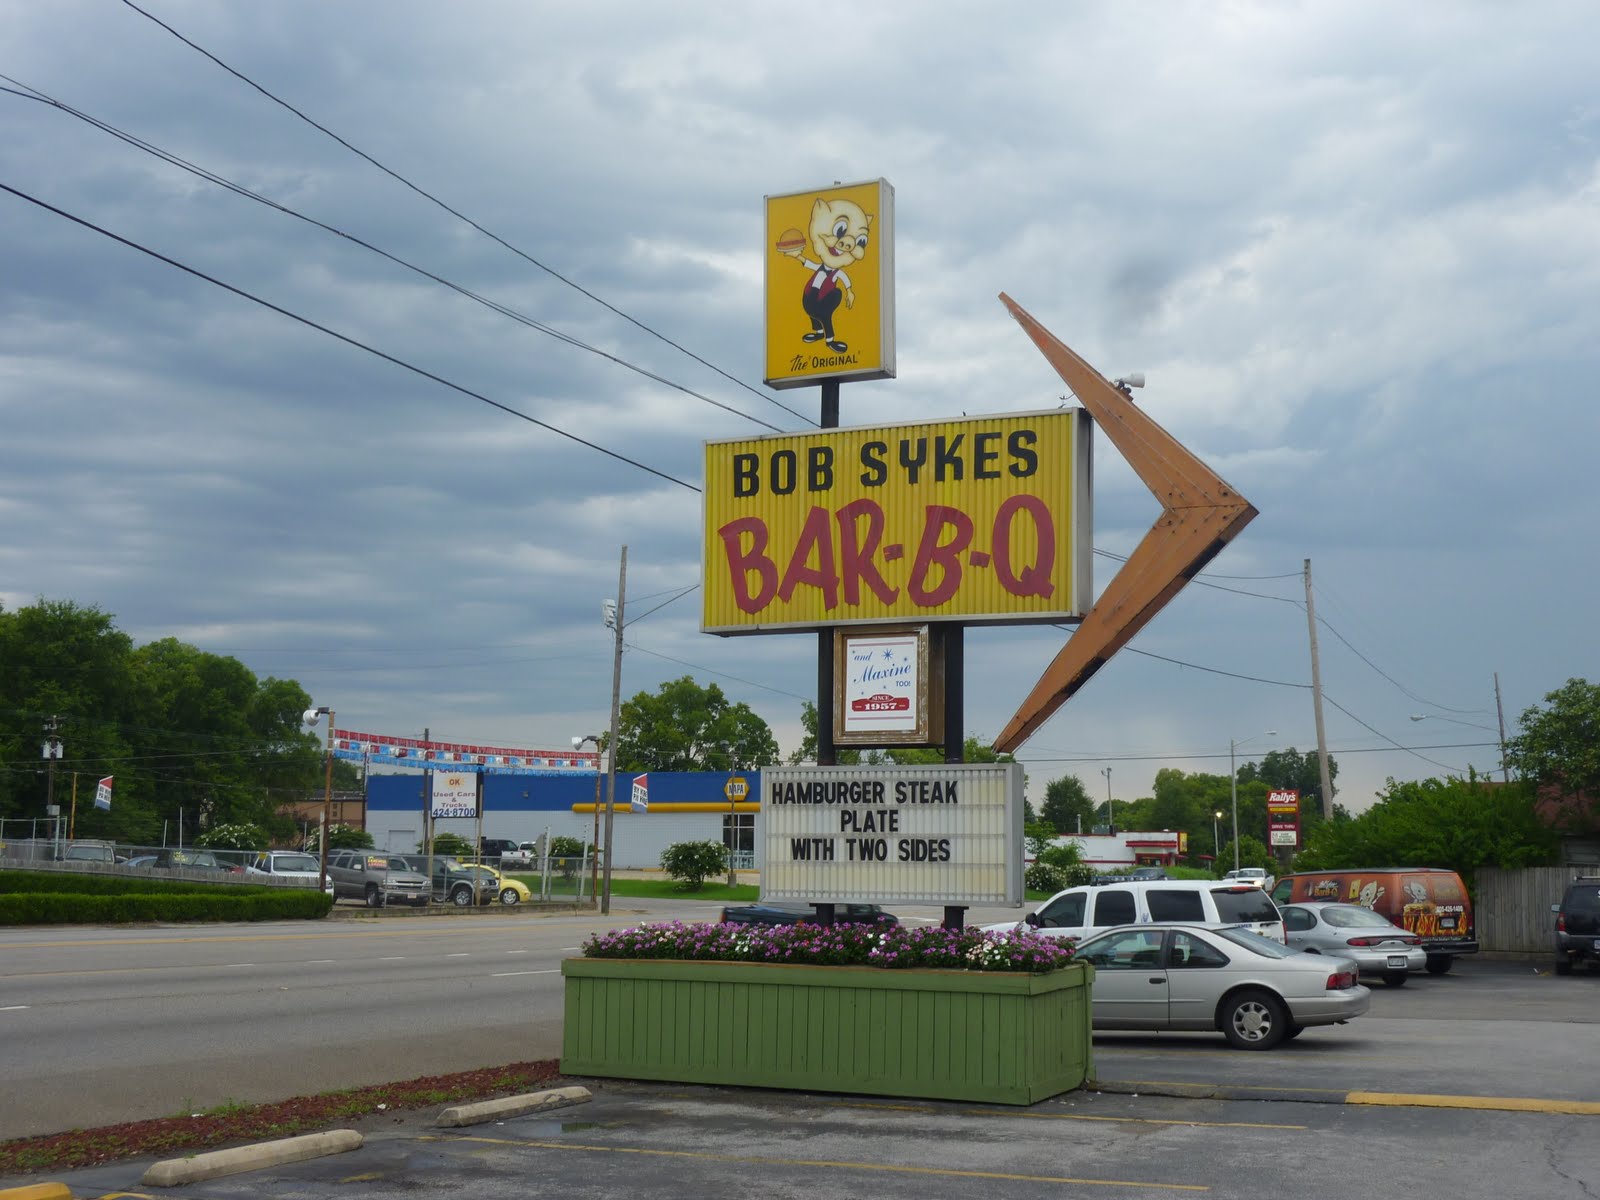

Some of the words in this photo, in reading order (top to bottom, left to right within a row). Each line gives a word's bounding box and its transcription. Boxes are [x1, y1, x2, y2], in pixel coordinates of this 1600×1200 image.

[789, 354, 808, 372] The
[733, 446, 834, 498] BOB
[860, 429, 1039, 488] SYKES
[717, 494, 1056, 615] BAR-B-Q
[854, 651, 873, 661] and
[853, 664, 911, 684] Maxine
[864, 702, 897, 711] 1957
[728, 784, 745, 795] NAPA
[772, 781, 885, 804] HAMBURGER
[895, 780, 959, 804] STEAK
[1269, 792, 1296, 803] Rally's
[840, 810, 899, 832] PLATE
[791, 838, 834, 861] WITH
[846, 838, 888, 861] TWO
[898, 839, 951, 862] SIDES
